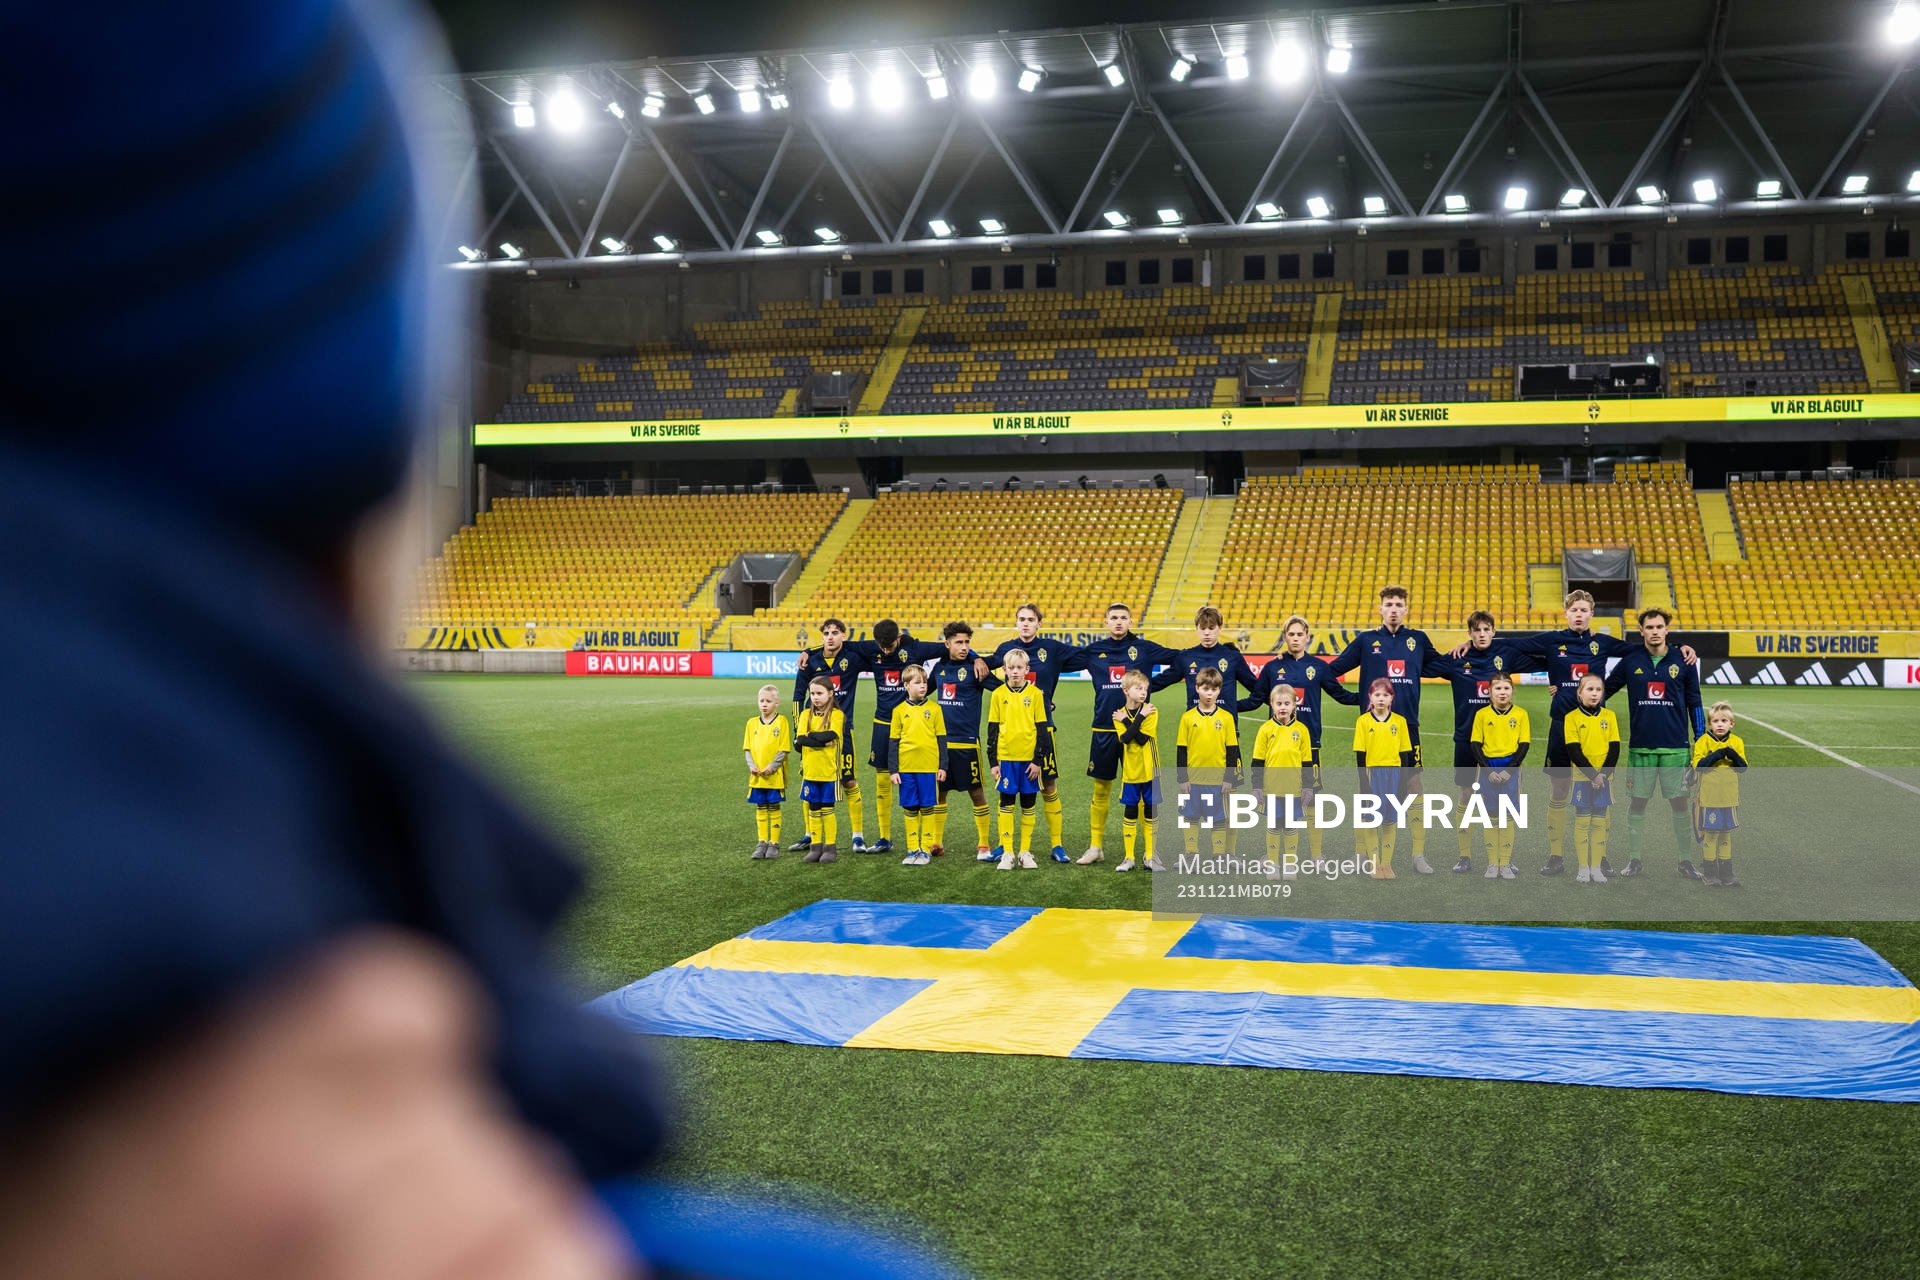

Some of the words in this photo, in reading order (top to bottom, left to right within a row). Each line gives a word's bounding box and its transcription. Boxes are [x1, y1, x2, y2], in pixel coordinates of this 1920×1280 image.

[1770, 401, 1784, 414] VI
[1787, 400, 1805, 413] ÄR
[1807, 398, 1864, 413] BLÅGULT
[993, 417, 1004, 429] VI
[1006, 416, 1021, 429] ÄR
[1023, 416, 1071, 429] BLÅGULT
[1365, 409, 1378, 422] VI
[1380, 408, 1396, 422] ÄR
[1399, 408, 1449, 421] SVERIGE
[631, 425, 641, 437] VI
[643, 424, 657, 437] ÄR
[659, 424, 701, 437] SVERIGE
[584, 631, 598, 647] VI
[600, 630, 619, 647] ÄR
[622, 630, 680, 647] BLÅGULT
[1755, 635, 1774, 653] VI
[1777, 633, 1802, 654] ÄR
[1805, 635, 1879, 654] SVERIGE
[587, 655, 691, 673] BAUHAUS
[745, 655, 801, 674] Folksa
[970, 761, 978, 776] 5
[1043, 756, 1056, 770] 14
